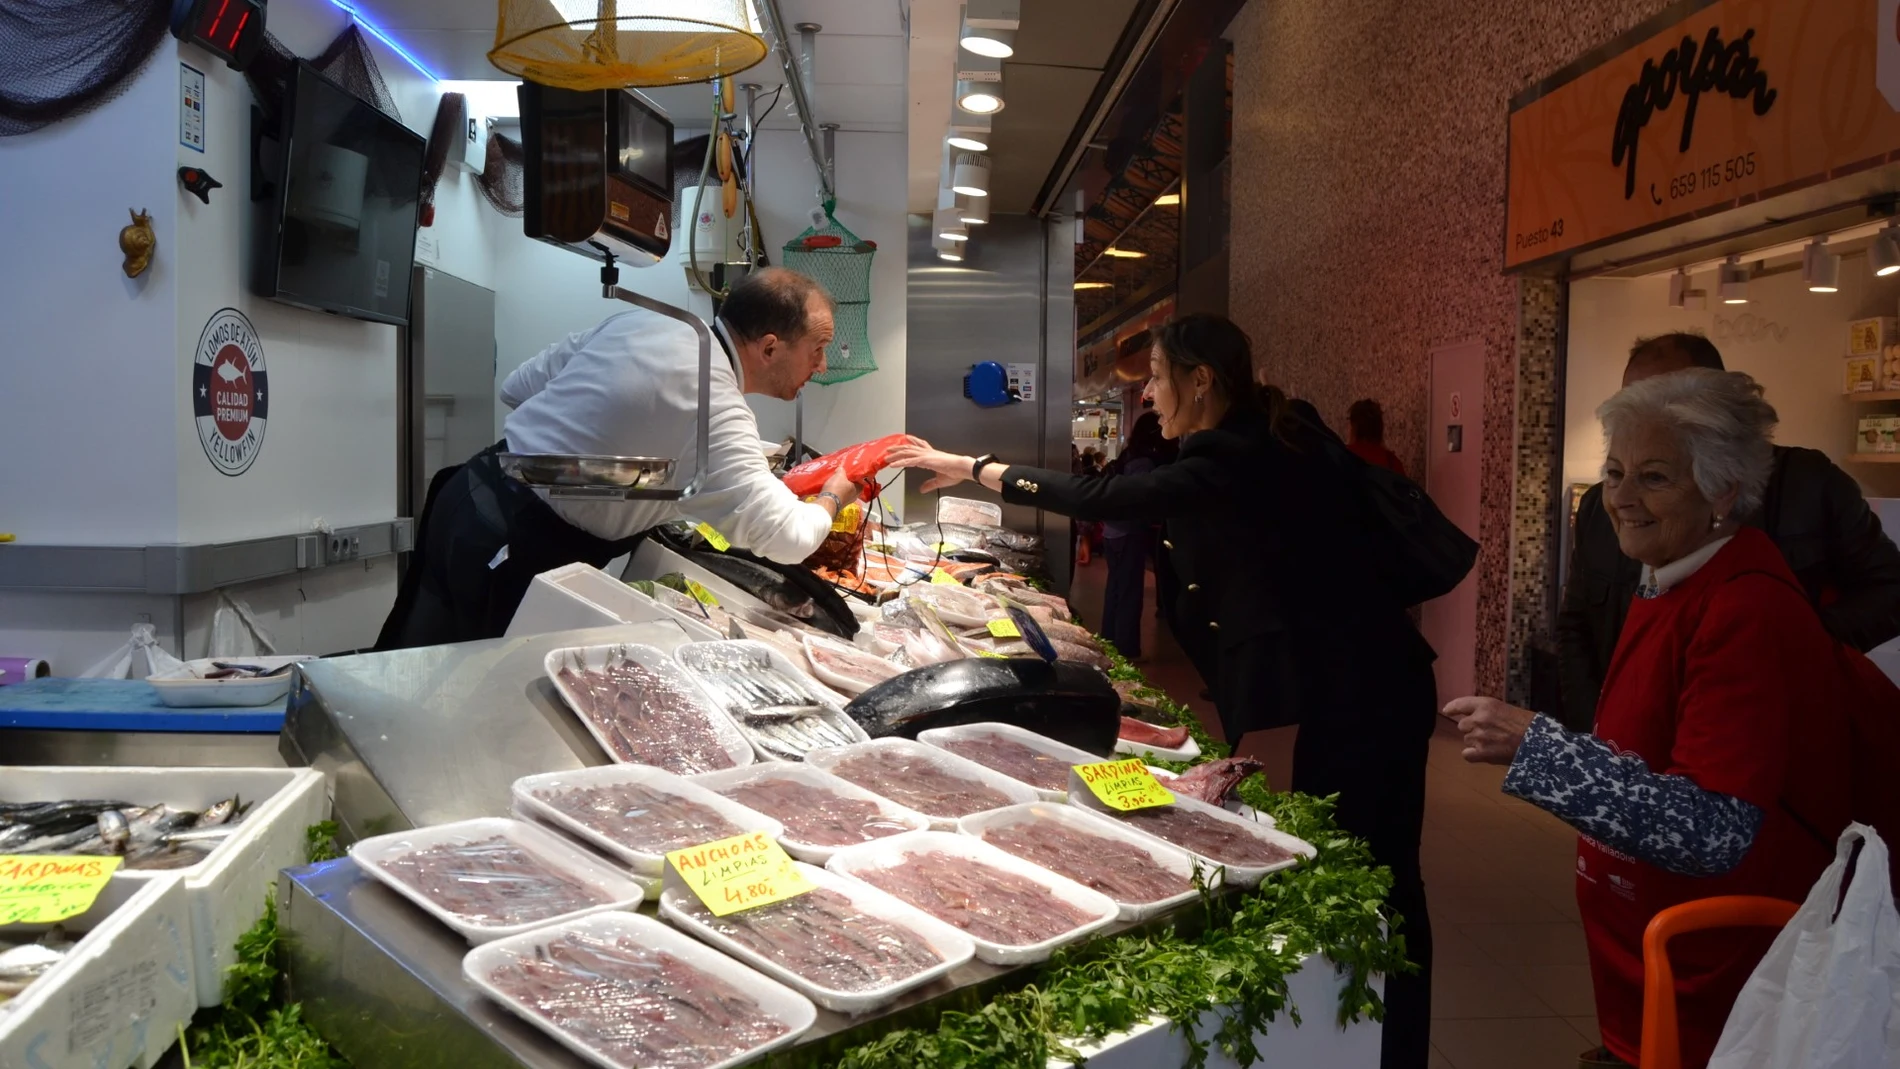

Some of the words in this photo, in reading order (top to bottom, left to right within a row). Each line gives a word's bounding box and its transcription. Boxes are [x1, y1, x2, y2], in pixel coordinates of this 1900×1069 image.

[208, 0, 250, 50] 11
[1669, 171, 1697, 200] 659
[1699, 163, 1721, 190] 115
[1724, 151, 1756, 183] 505
[1515, 228, 1549, 251] Puesto
[1549, 218, 1565, 238] 43
[204, 322, 230, 364] LOMOS
[230, 322, 241, 343] DE
[216, 390, 249, 407] CALIDAD
[216, 407, 249, 424] PREMIUM
[208, 426, 257, 464] YELLOWFIN
[1081, 759, 1150, 783] SARDINAS
[1104, 776, 1143, 796] LIMPIAS
[678, 834, 769, 872] ANCHOAS
[702, 854, 768, 887] LIMPIAS
